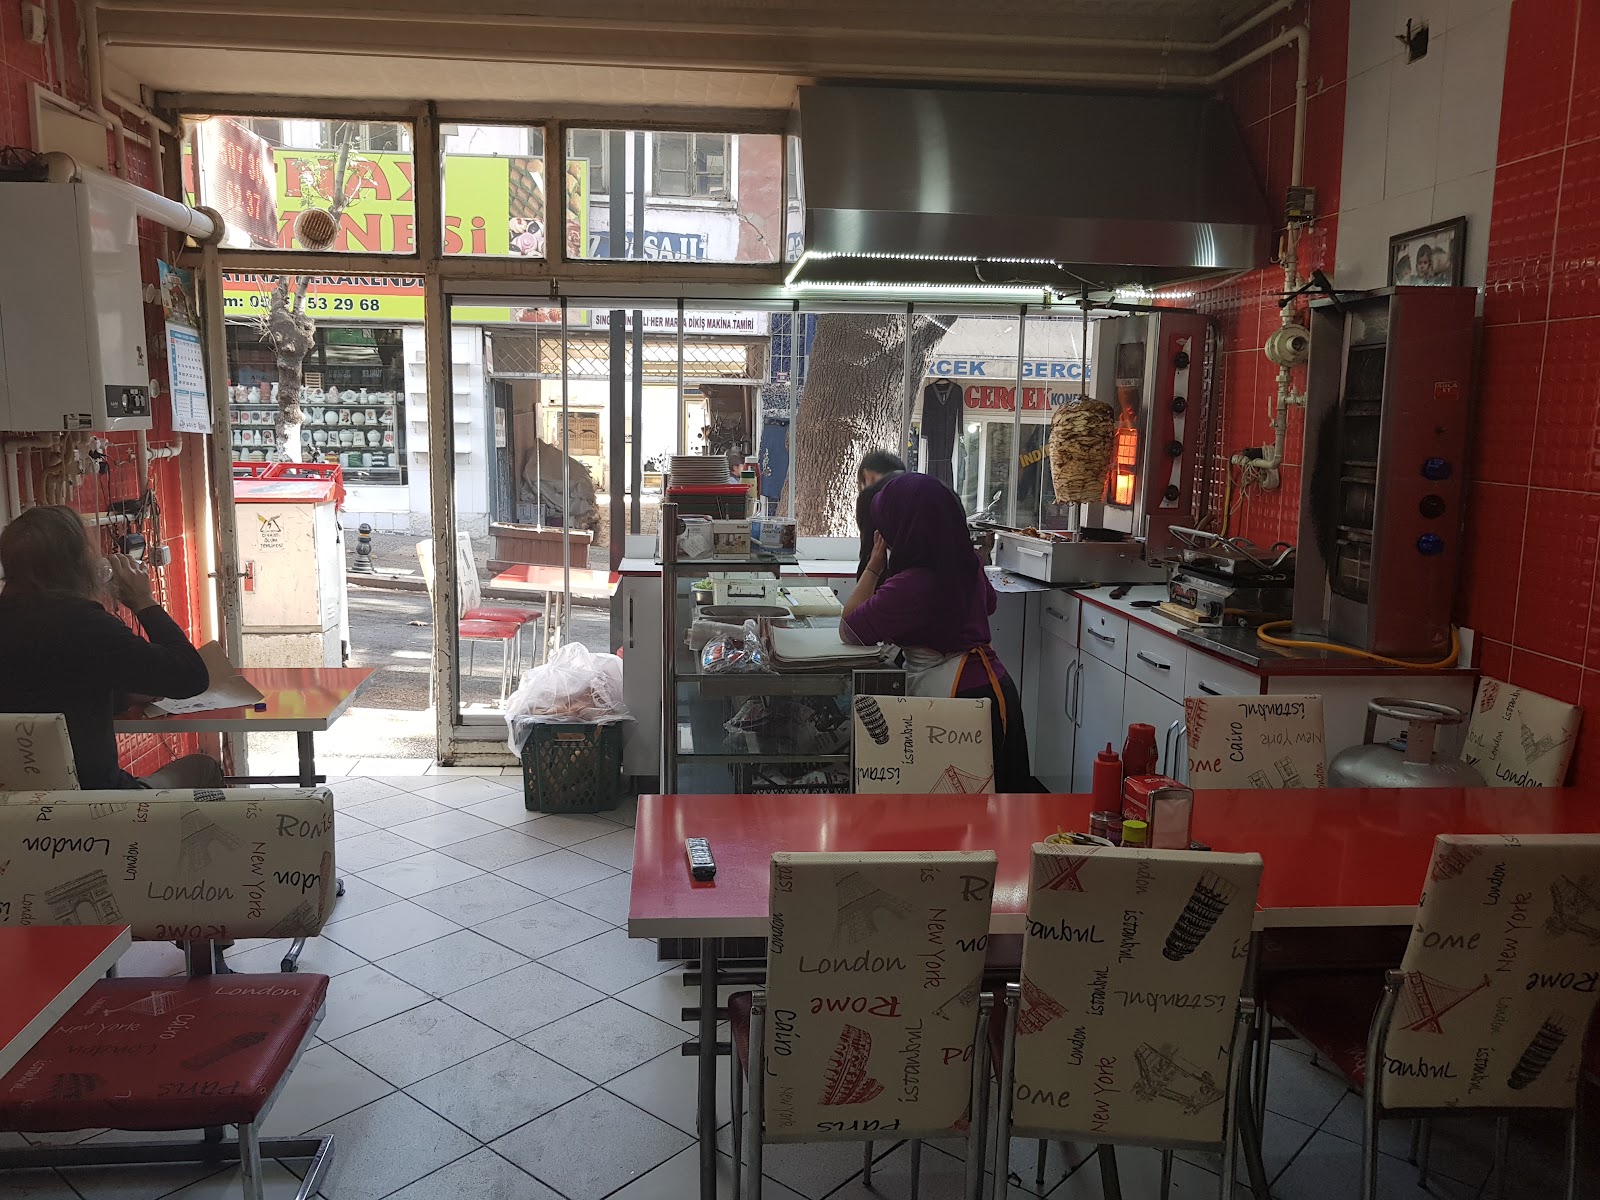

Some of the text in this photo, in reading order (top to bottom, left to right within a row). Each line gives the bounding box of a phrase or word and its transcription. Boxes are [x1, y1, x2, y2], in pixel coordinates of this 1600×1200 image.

[333, 298, 354, 310] 29
[359, 299, 380, 311] 68
[651, 317, 663, 327] HER
[665, 317, 686, 328] MARA
[688, 316, 706, 330] DİKİŞ
[706, 317, 731, 329] MAKİNA
[925, 725, 983, 745] Rome
[22, 836, 110, 859] London
[124, 842, 139, 881] London
[250, 841, 267, 876] New
[147, 879, 234, 901] London
[1482, 861, 1506, 906] London
[770, 912, 785, 954] London
[926, 908, 947, 945] New
[799, 949, 907, 974] London
[1495, 937, 1519, 972] New
[214, 984, 303, 997] London
[1525, 972, 1599, 993] Rome
[810, 996, 902, 1018] Rome
[774, 1009, 801, 1057] Cairo
[1067, 1025, 1088, 1066] London
[1090, 1099, 1111, 1133] New
